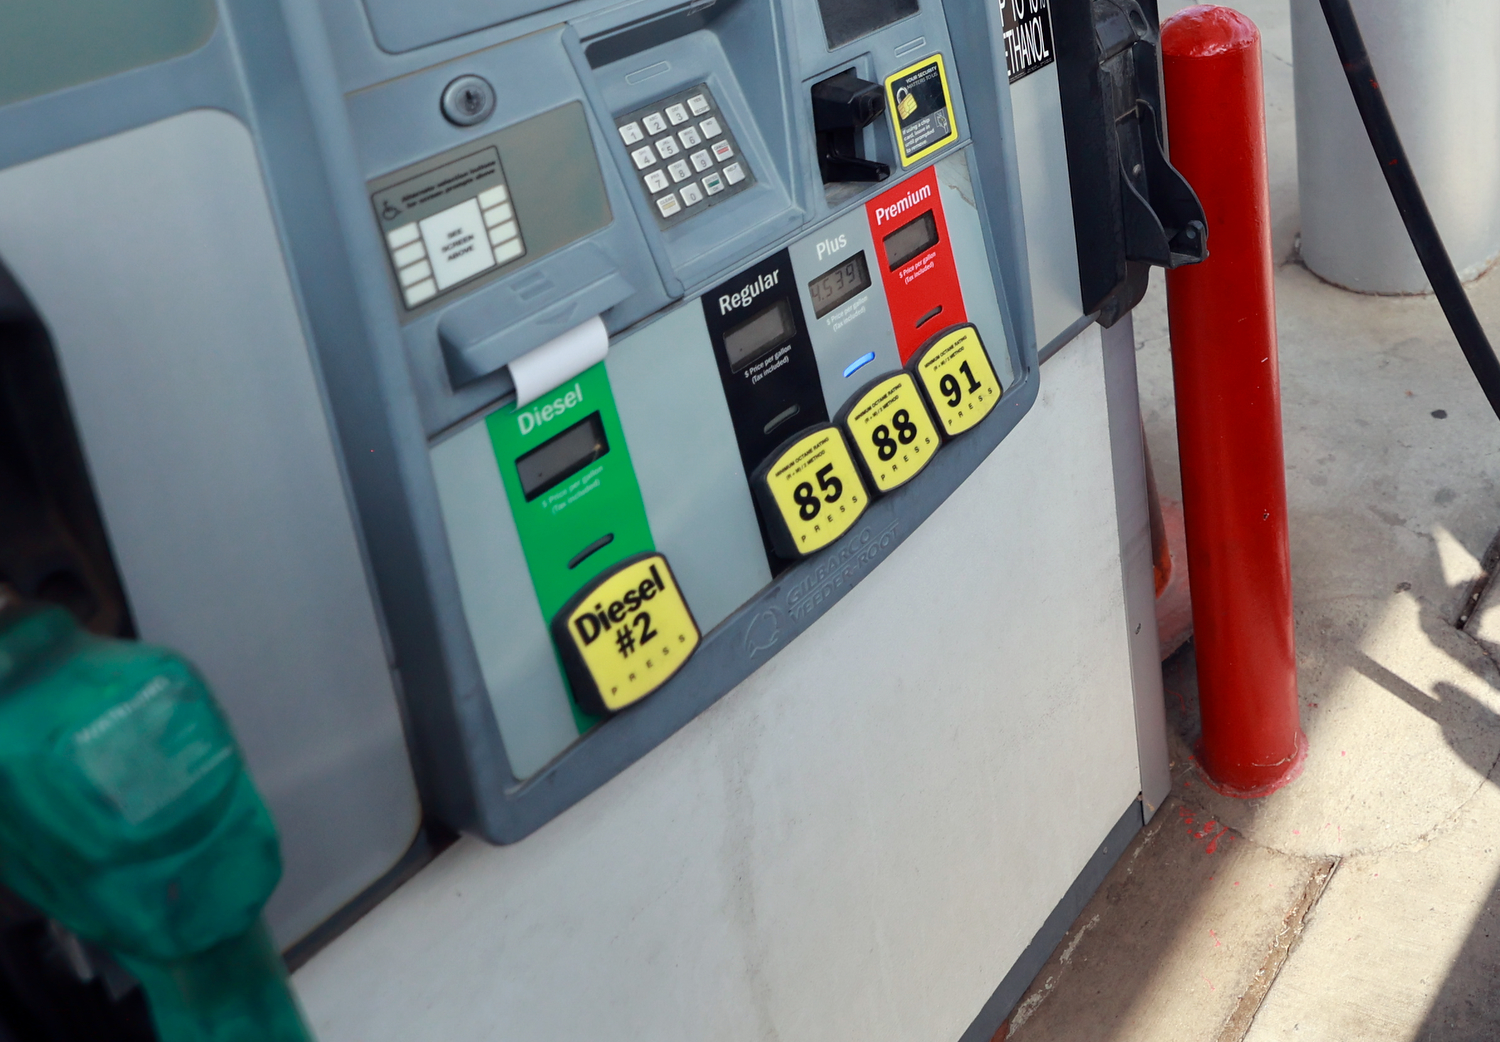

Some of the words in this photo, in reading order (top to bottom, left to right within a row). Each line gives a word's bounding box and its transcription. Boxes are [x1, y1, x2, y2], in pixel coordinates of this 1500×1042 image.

[917, 65, 937, 78] SECURITY
[654, 122, 661, 130] 2
[676, 113, 683, 121] 3
[631, 132, 637, 140] 1
[667, 146, 673, 154] 5
[688, 136, 695, 144] 6
[644, 156, 650, 164] 4
[678, 169, 685, 178] 8
[700, 159, 707, 167] 9
[655, 180, 662, 188] 7
[690, 193, 696, 201] 0
[875, 184, 931, 226] Premium
[816, 233, 848, 260] Plus
[903, 263, 915, 276] Price
[915, 258, 923, 268] per
[923, 251, 936, 265] gallon
[914, 261, 934, 277] included)
[719, 269, 779, 316] Regular
[811, 263, 855, 302] 4.539
[744, 370, 749, 378] $
[749, 361, 765, 375] Price
[764, 356, 774, 367] per
[774, 344, 792, 359] gallon
[751, 373, 763, 385] (Tax
[763, 355, 789, 375] included)
[939, 359, 982, 408] 91
[517, 382, 583, 436] Diesel
[872, 409, 917, 462] 88
[793, 462, 843, 522] 85
[786, 525, 872, 607] GILBARCO
[788, 525, 899, 625] VEEDER-ROOT
[574, 564, 665, 647] Diesel
[615, 611, 658, 658] #2
[611, 634, 685, 696] PRESS
